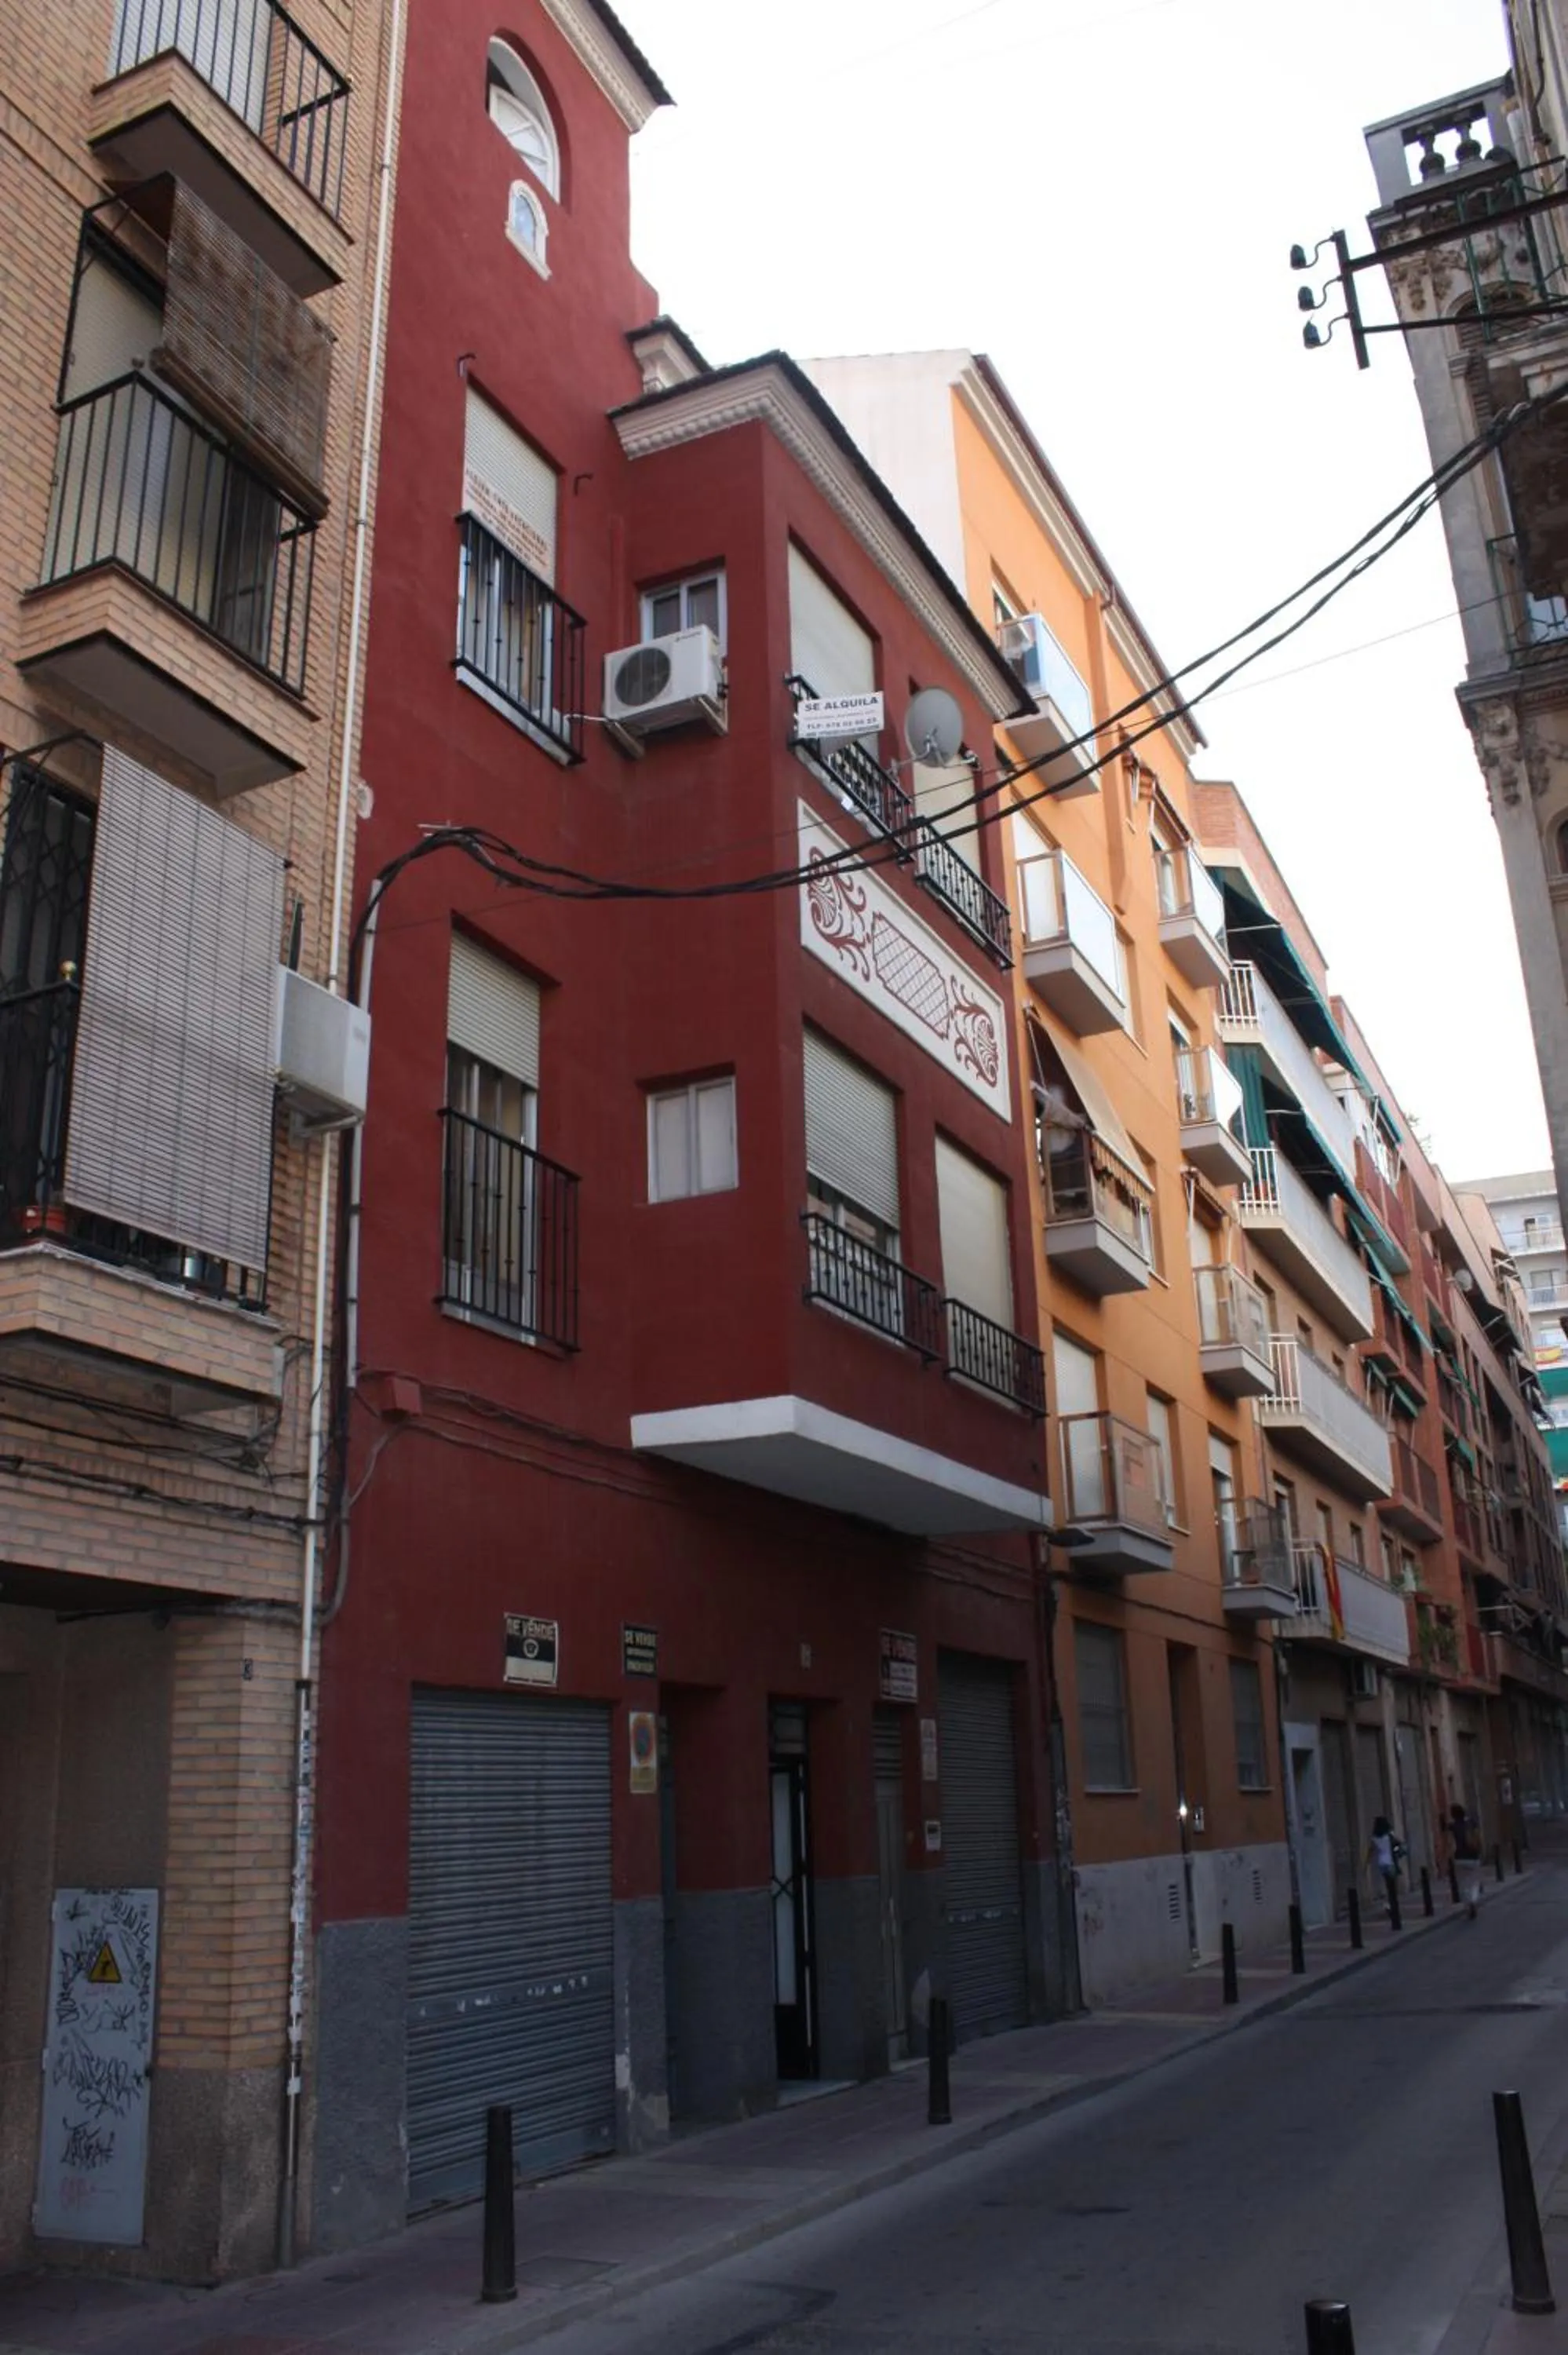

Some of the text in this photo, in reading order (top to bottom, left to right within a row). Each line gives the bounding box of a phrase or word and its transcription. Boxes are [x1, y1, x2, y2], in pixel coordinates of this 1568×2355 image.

[804, 696, 878, 711] SE ALQUILA
[522, 1620, 556, 1641] VENDE
